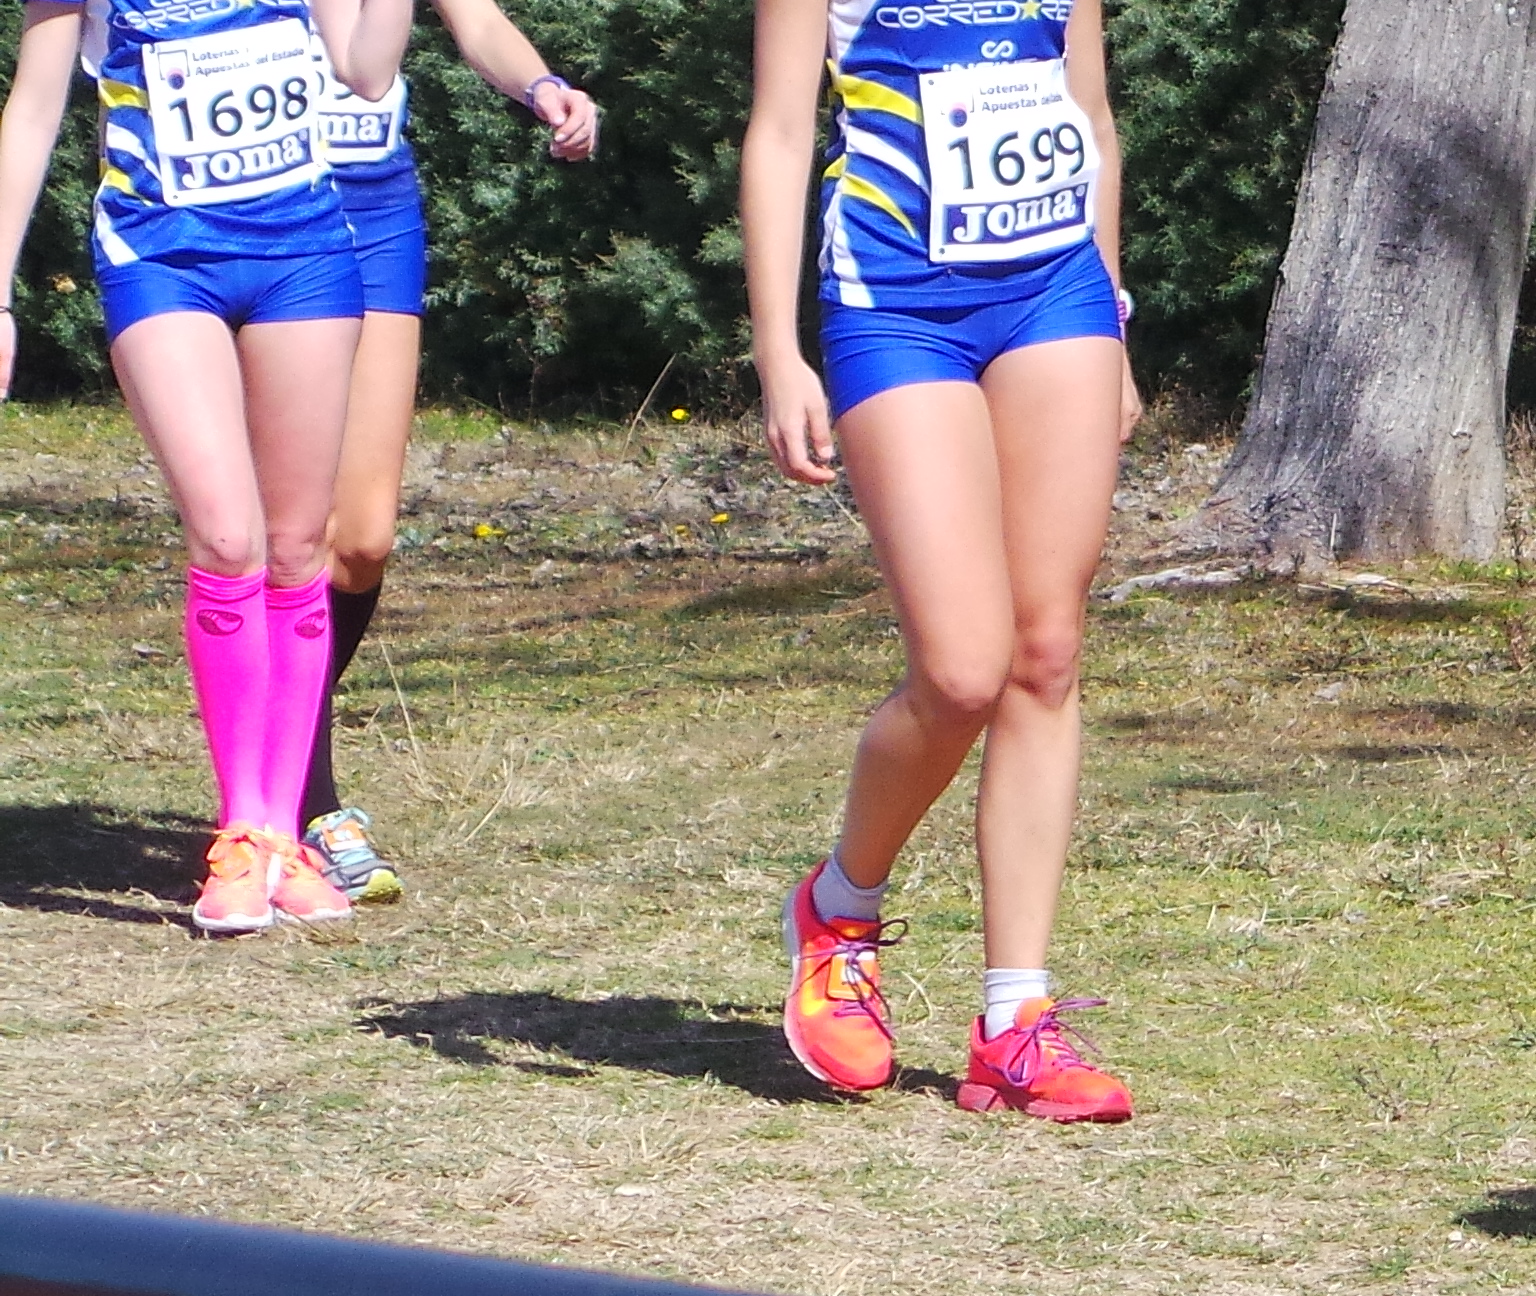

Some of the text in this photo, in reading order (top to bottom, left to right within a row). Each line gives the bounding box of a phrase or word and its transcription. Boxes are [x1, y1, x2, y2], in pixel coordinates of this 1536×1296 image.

[195, 60, 250, 78] Apuestas
[168, 77, 308, 142] 1698
[982, 98, 1037, 113] Apuestas
[322, 114, 380, 142] ma
[948, 122, 1086, 190] 1699
